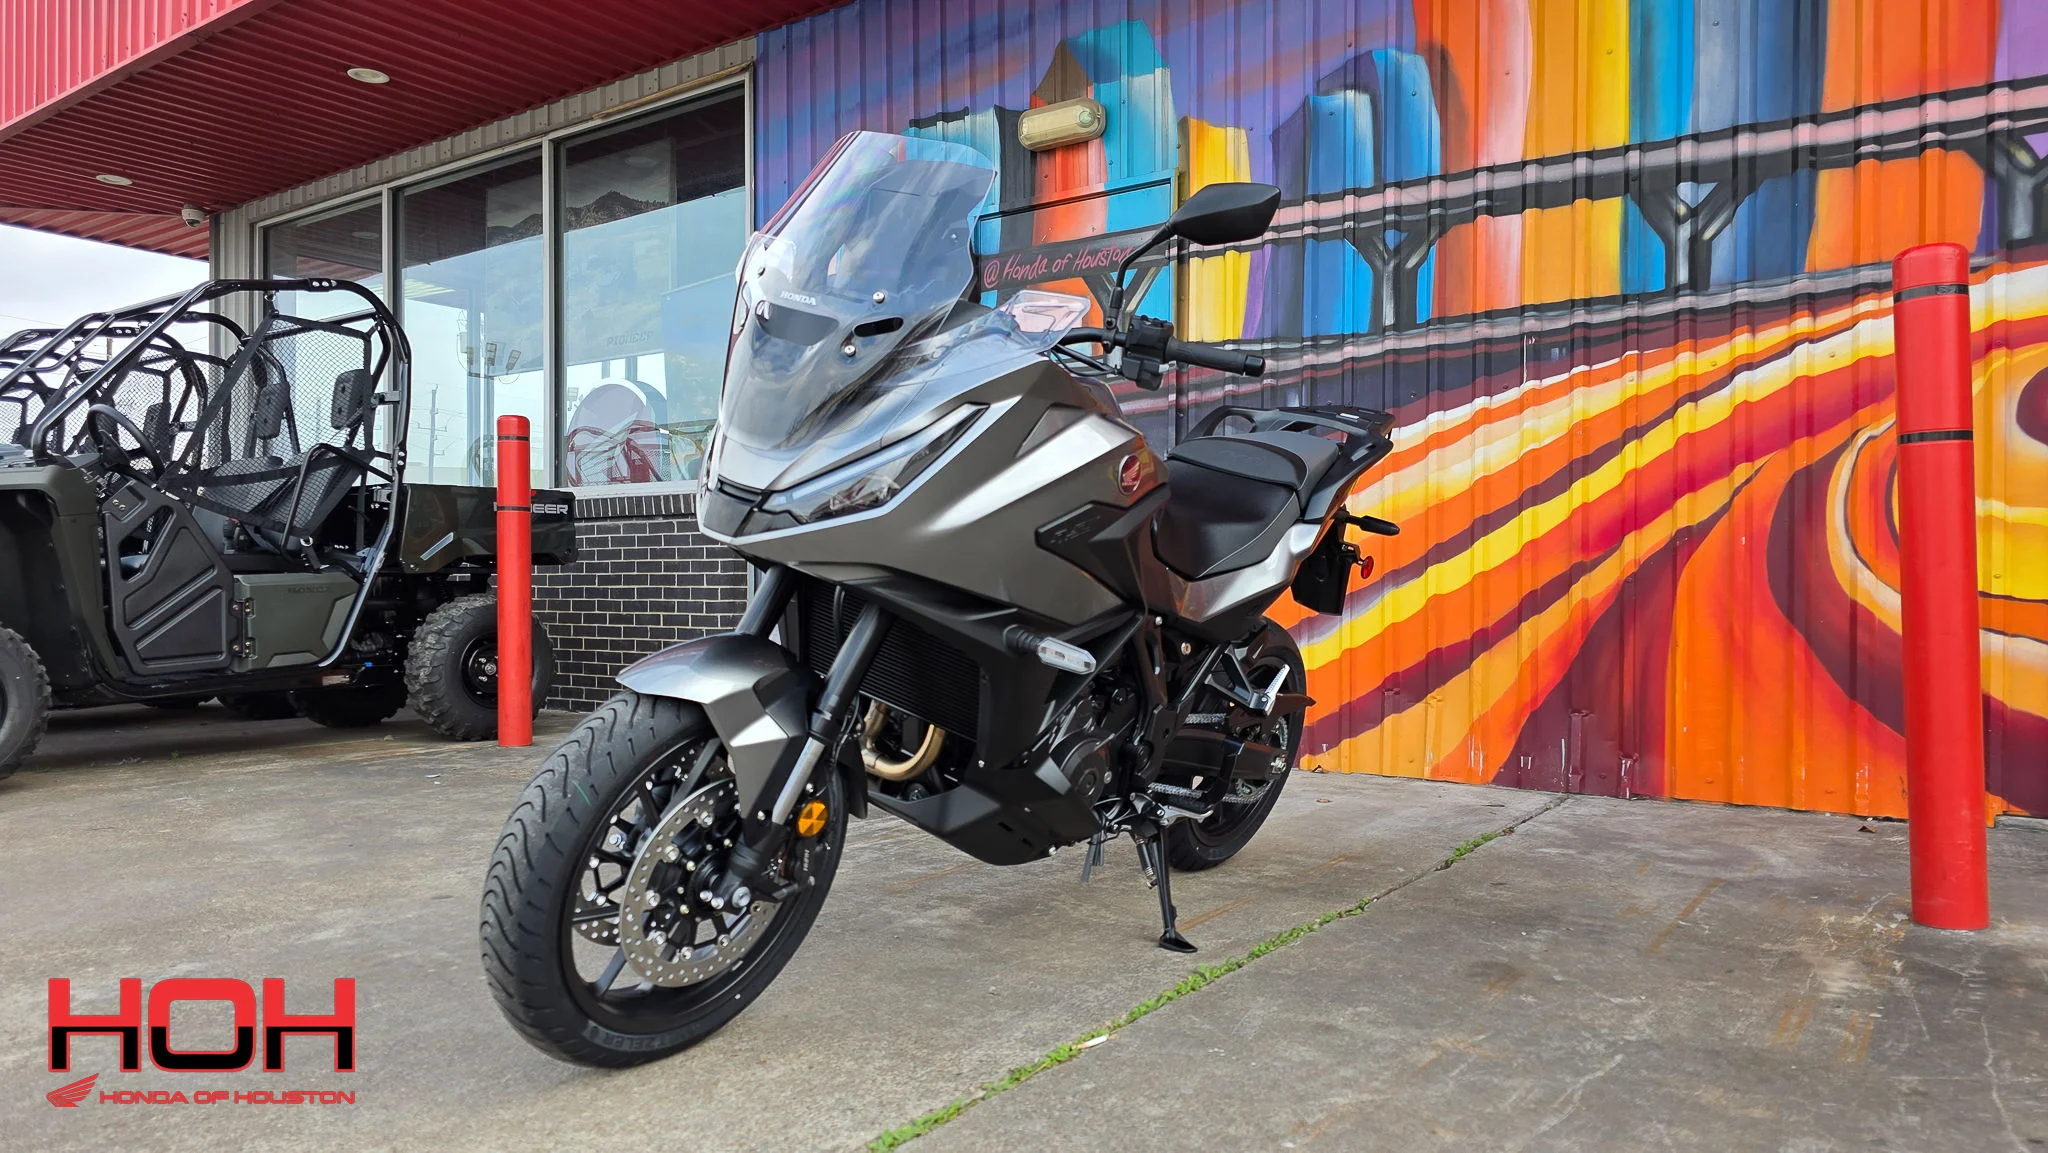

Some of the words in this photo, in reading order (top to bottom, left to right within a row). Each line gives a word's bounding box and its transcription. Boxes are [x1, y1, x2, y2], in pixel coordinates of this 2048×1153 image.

[983, 260, 1000, 288] @
[1003, 254, 1048, 281] Honda
[1052, 255, 1073, 273] of
[780, 290, 817, 306] HONDA
